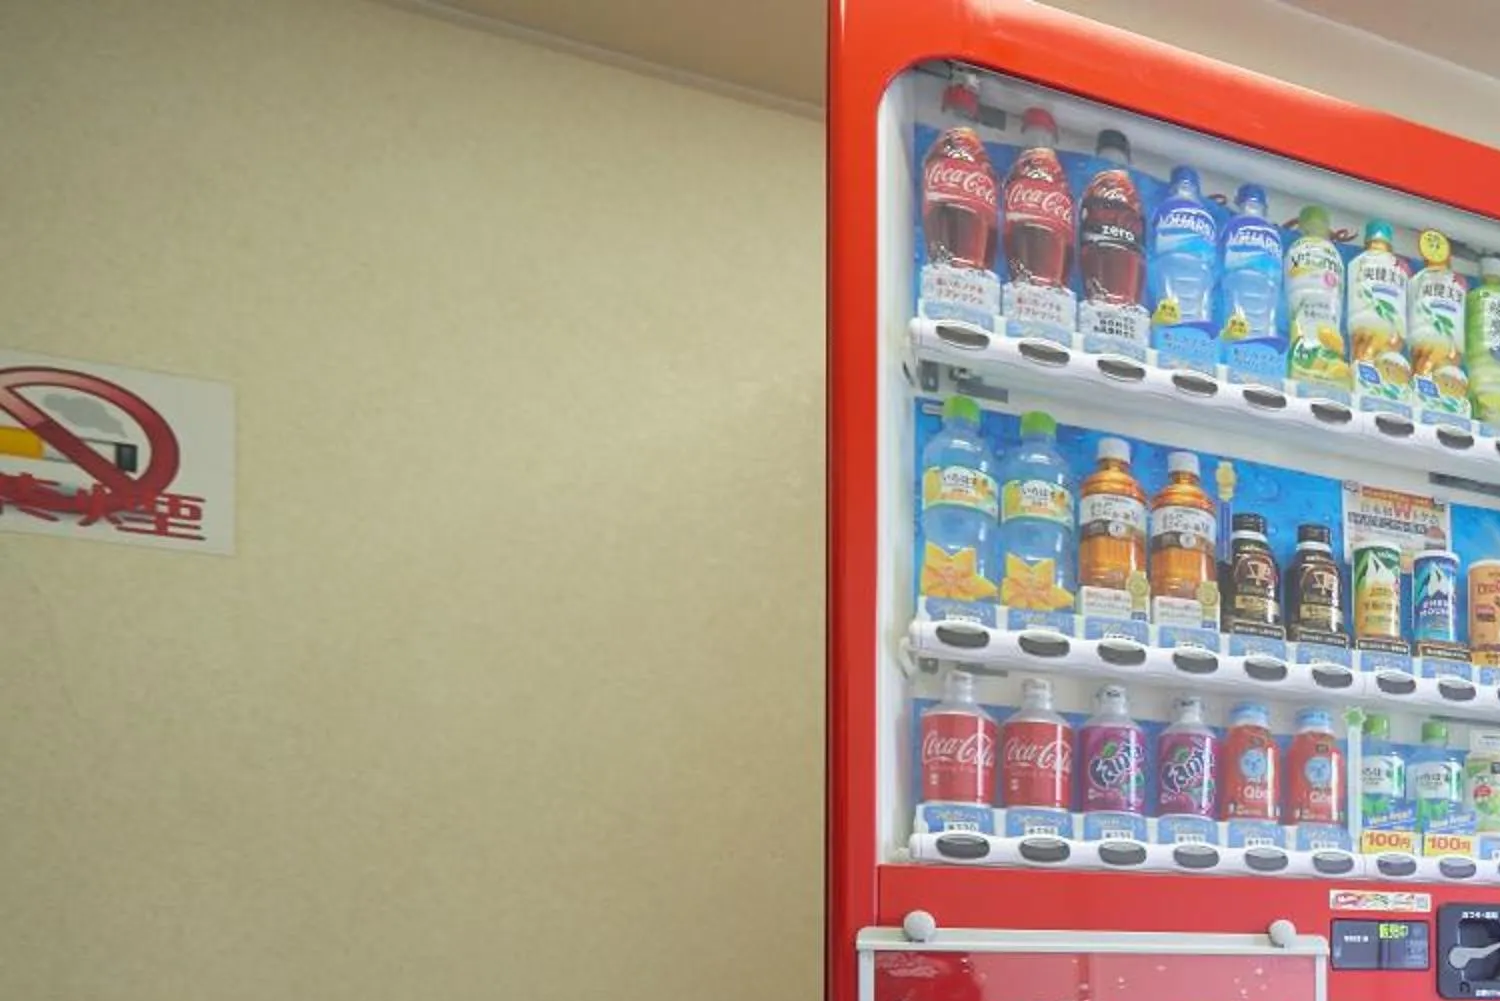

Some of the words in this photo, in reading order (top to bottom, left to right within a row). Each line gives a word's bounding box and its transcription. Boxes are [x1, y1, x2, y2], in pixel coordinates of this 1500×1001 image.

[926, 163, 997, 205] Coca-Col
[1006, 183, 1073, 225] Coca-Col
[1101, 223, 1135, 242] zero
